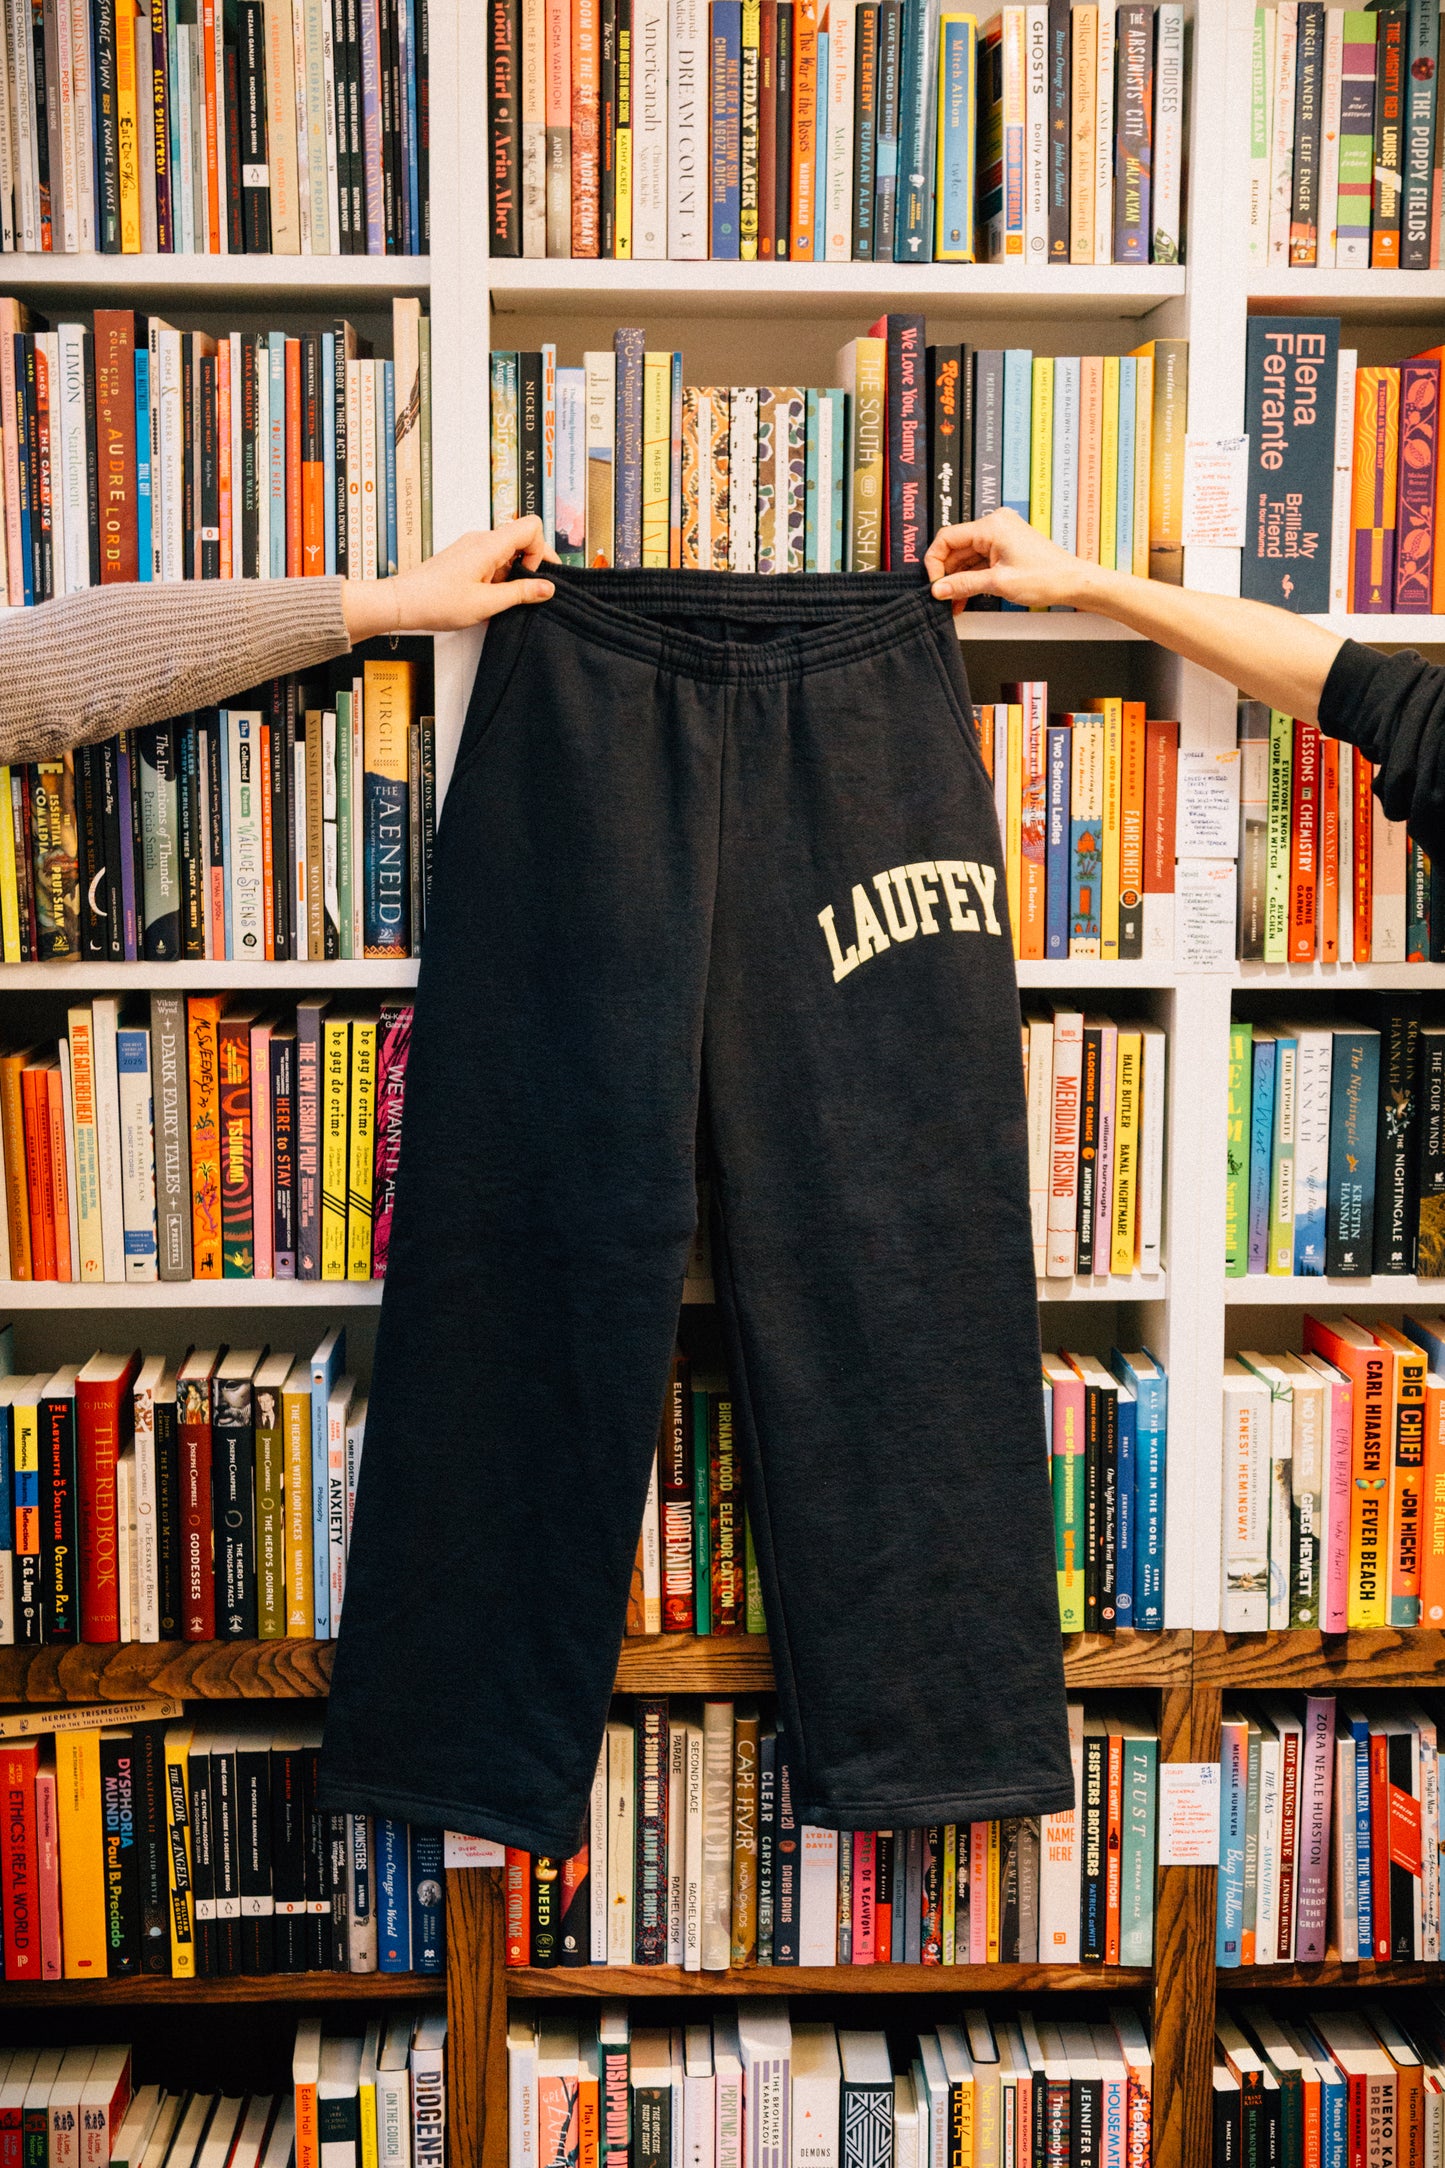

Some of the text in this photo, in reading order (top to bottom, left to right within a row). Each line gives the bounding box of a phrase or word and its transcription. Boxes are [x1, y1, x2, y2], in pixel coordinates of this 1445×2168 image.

[362, 1, 376, 94] The New Book
[644, 12, 662, 131] Americanah
[951, 40, 964, 128] Mitch Albom
[1053, 30, 1065, 108] Bitter Orange Tree
[1125, 30, 1143, 137] ARSONISTS' CITY
[1162, 17, 1179, 113] SALT HOUSES
[678, 50, 695, 218] DREAM COUNT
[742, 49, 756, 208] FRIDAY BLACK
[859, 10, 874, 228] ENTITLEMENT RUMAAN ALAM
[1032, 21, 1044, 213] GHOSTS Dolly Alderton
[1299, 14, 1316, 211] VIRGIL WANDER LEIF ENGER
[1407, 91, 1431, 242] THE POPPY FIELDS
[335, 339, 344, 389] TINDERBOX
[336, 394, 344, 403] IN
[526, 381, 535, 431] NICKED
[623, 368, 635, 464] Margaret Atwood
[860, 358, 880, 462] THE SOUTH
[900, 328, 918, 465] We Love You, Bunny
[1260, 332, 1326, 470] Elena Ferrante
[66, 342, 83, 508] LIMÓN Startlement
[336, 407, 345, 434] THREE
[337, 438, 346, 460] ACTS
[106, 429, 125, 571] AUDRE LORDE
[903, 482, 919, 563] Mona Awad
[1267, 493, 1319, 559] My Brilliant Friend
[144, 790, 157, 870] Patricia Smith
[156, 734, 171, 897] The Intentions of Thunder
[378, 686, 401, 924] VIRGIL AENEID
[1051, 735, 1064, 845] Two Serious Ladies
[1298, 727, 1315, 872] LESSONS CHEMISTRY
[1123, 810, 1139, 886] FAHRENHEIT
[817, 860, 1002, 983] LAUFEY
[1296, 884, 1313, 926] BONNIE GARMUS
[161, 1033, 180, 1194] DARK FAIRY TALES
[299, 1041, 317, 1174] THE NEW LESBIAN PULP
[358, 1031, 373, 1137] be gay do crime
[1121, 1054, 1133, 1128] HALLE BUTLER
[276, 1097, 291, 1187] HERE to STAY
[1052, 1076, 1078, 1197] MERIDIAN RISING
[1393, 1134, 1405, 1242] THE NIGHTINGALE
[1339, 1182, 1362, 1240] KRISTIN HANNAH
[673, 1382, 684, 1486] ELAINE CASTILLO
[1399, 1365, 1424, 1463] BIG CHIEF
[94, 1421, 116, 1590] THE RED BOOK
[329, 1478, 343, 1545] ANXIETY
[718, 1402, 735, 1608] BIRNAM WOOD ELEANOR CATTON
[1237, 1409, 1251, 1541] ERNEST HEMINGWAY
[1360, 1360, 1384, 1601] CARL HIAASEN FEVER BEACH
[105, 1758, 134, 1849] DYSPHORIA MUNDI
[1086, 1751, 1100, 1877] SISTERS BROTHERS
[1132, 1755, 1147, 1837] TRUST
[1310, 1714, 1328, 1865] ZORA NEALE HURSTON
[107, 1837, 124, 1948] Paul B. Preciado
[354, 1823, 367, 1870] MONSTERS
[688, 1741, 699, 1949] SECOND PLACE RACHEL CUSK
[761, 1771, 774, 1925] CLEAR CARYS DAVIES
[1225, 1848, 1243, 1929] Bug Hollow
[539, 1884, 549, 1926] NEED
[1358, 1857, 1371, 1945] THE WHALE RIDER
[386, 2106, 399, 2156] THE COUCH
[604, 2054, 628, 2146] DISAPPOINT
[772, 2097, 780, 2146] BROTHERS
[1050, 2119, 1064, 2155] Candy
[1081, 2087, 1092, 2154] JENNIFER
[1382, 2085, 1393, 2138] MIEKO
